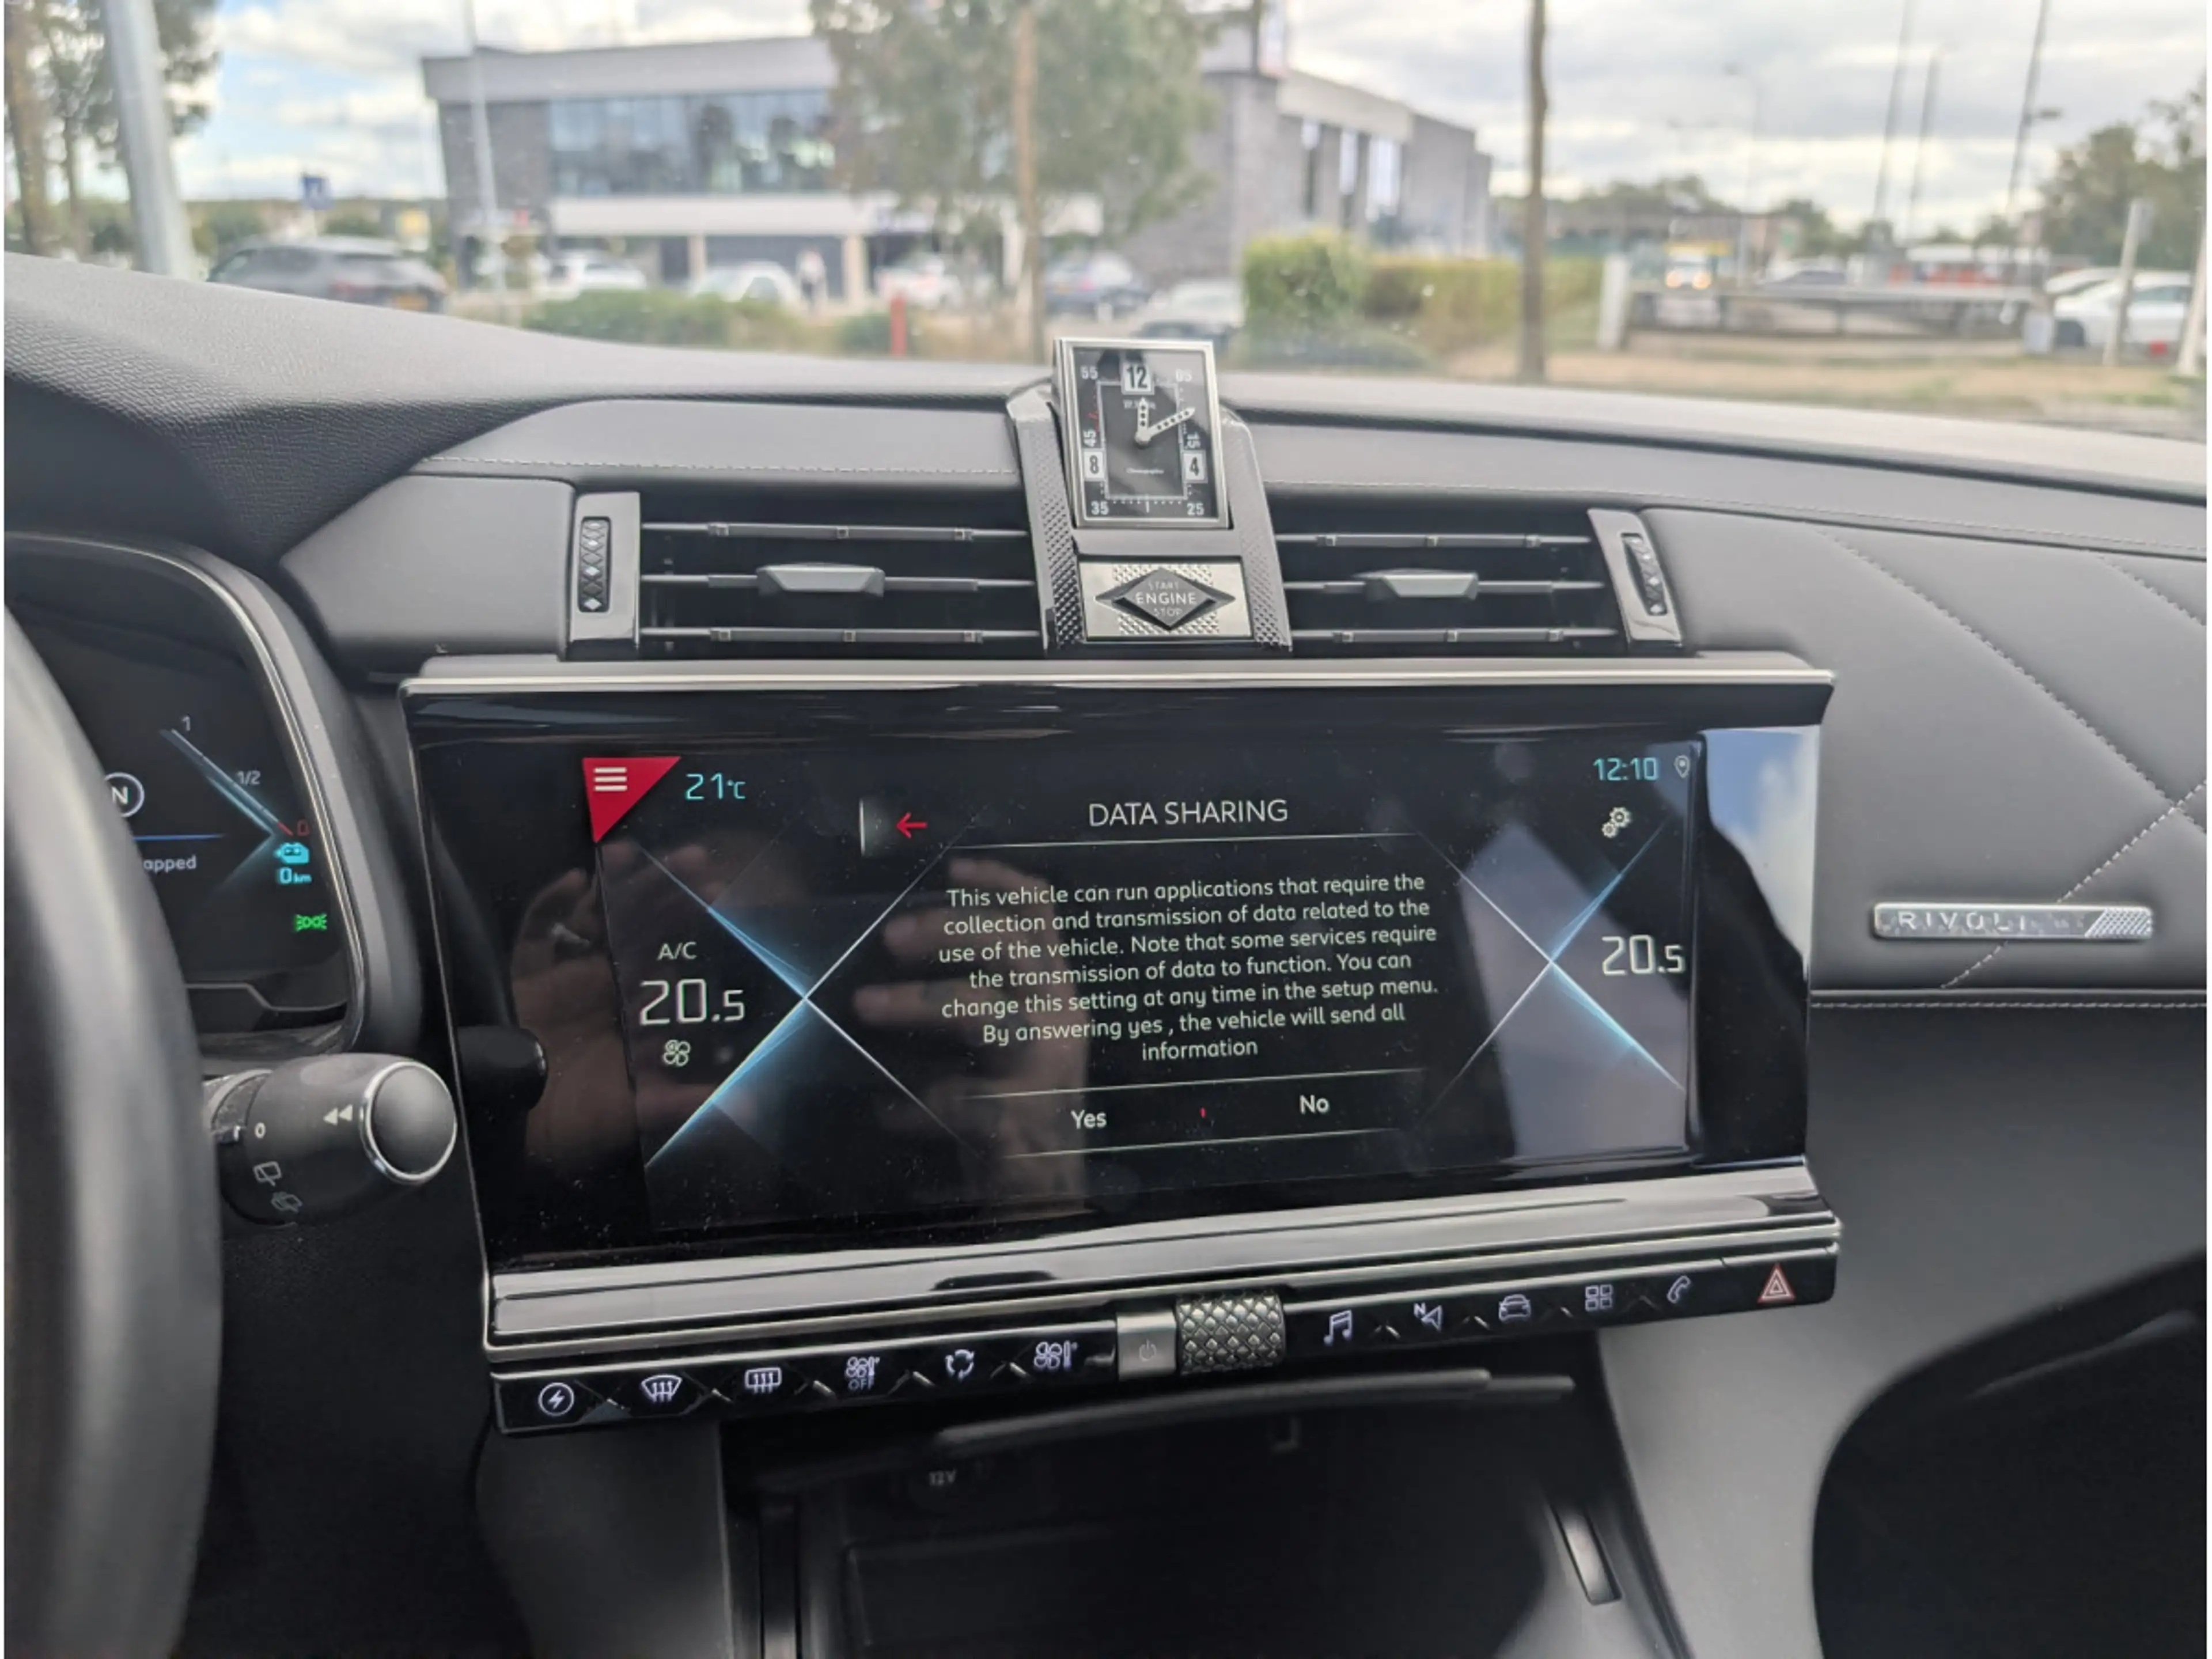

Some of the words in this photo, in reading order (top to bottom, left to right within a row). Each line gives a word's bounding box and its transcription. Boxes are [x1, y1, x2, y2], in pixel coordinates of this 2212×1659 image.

[1080, 365, 1099, 380] 55
[1126, 365, 1148, 390] 12
[1083, 427, 1097, 448] 45
[1088, 454, 1100, 475] 8
[1188, 456, 1200, 476] 4
[1090, 501, 1109, 516] 35
[1186, 502, 1205, 516] 25
[1147, 581, 1179, 590] START
[1135, 592, 1196, 605] ENGINE
[1153, 608, 1183, 616] STOP
[181, 716, 192, 732] 1
[236, 770, 261, 786] 1/2
[1592, 756, 1660, 782] 12:10
[111, 786, 129, 805] N
[1088, 802, 1158, 828] DATA
[1164, 799, 1289, 825] SHARING
[297, 821, 309, 836] 0
[946, 888, 991, 908] This
[996, 885, 1069, 905] vehicle
[1074, 886, 1110, 903] can
[1116, 885, 1149, 901] run
[1154, 879, 1273, 903] applications
[1278, 877, 1318, 895] that
[1323, 875, 1389, 896] require
[1394, 873, 1426, 891] the
[943, 915, 1046, 935] collection
[1052, 911, 1090, 931] and
[1096, 906, 1222, 929] transmission
[1228, 904, 1249, 923] of
[1252, 903, 1297, 922] data
[1302, 900, 1369, 921] related
[1373, 901, 1394, 917] to
[1399, 899, 1430, 916] the
[1897, 910, 2026, 931] RIVOLI
[657, 941, 697, 961] A/C
[938, 946, 975, 963] use
[980, 942, 1003, 961] of
[1007, 941, 1041, 960] the
[1047, 936, 1124, 957] vehicle.
[1131, 935, 1180, 954] Note
[1185, 933, 1226, 952] that
[1230, 931, 1284, 949] some
[1290, 927, 1367, 947] services
[1371, 925, 1437, 946] require
[1601, 933, 1687, 976] 20.5
[969, 970, 1003, 989] the
[1009, 966, 1139, 987] transmission
[1145, 961, 1166, 980] of
[1171, 960, 1215, 979] data
[1221, 959, 1241, 976] to
[1247, 956, 1332, 975] function.
[1336, 953, 1373, 971] You
[1377, 953, 1412, 969] can
[639, 978, 746, 1026] 20.5
[941, 998, 1018, 1019] change
[1025, 995, 1063, 1014] this
[1068, 991, 1137, 1013] setting
[1143, 989, 1163, 1007] at
[1169, 989, 1206, 1008] any
[1211, 985, 1256, 1003] time
[1262, 983, 1279, 1001] in
[1284, 982, 1317, 1000] the
[1321, 980, 1374, 1000] setup
[1379, 979, 1439, 995] menu.
[983, 1025, 1010, 1046] By
[1015, 1020, 1122, 1041] answering
[1127, 1018, 1163, 1039] yes
[1179, 1014, 1212, 1032] the
[1217, 1010, 1286, 1030] vehicle
[1290, 1006, 1325, 1027] will
[1330, 1004, 1376, 1025] send
[1381, 1002, 1406, 1022] all
[1142, 1039, 1258, 1061] information
[1298, 1094, 1330, 1115] No
[1070, 1109, 1108, 1130] Yes
[929, 1470, 956, 1486] 12V
